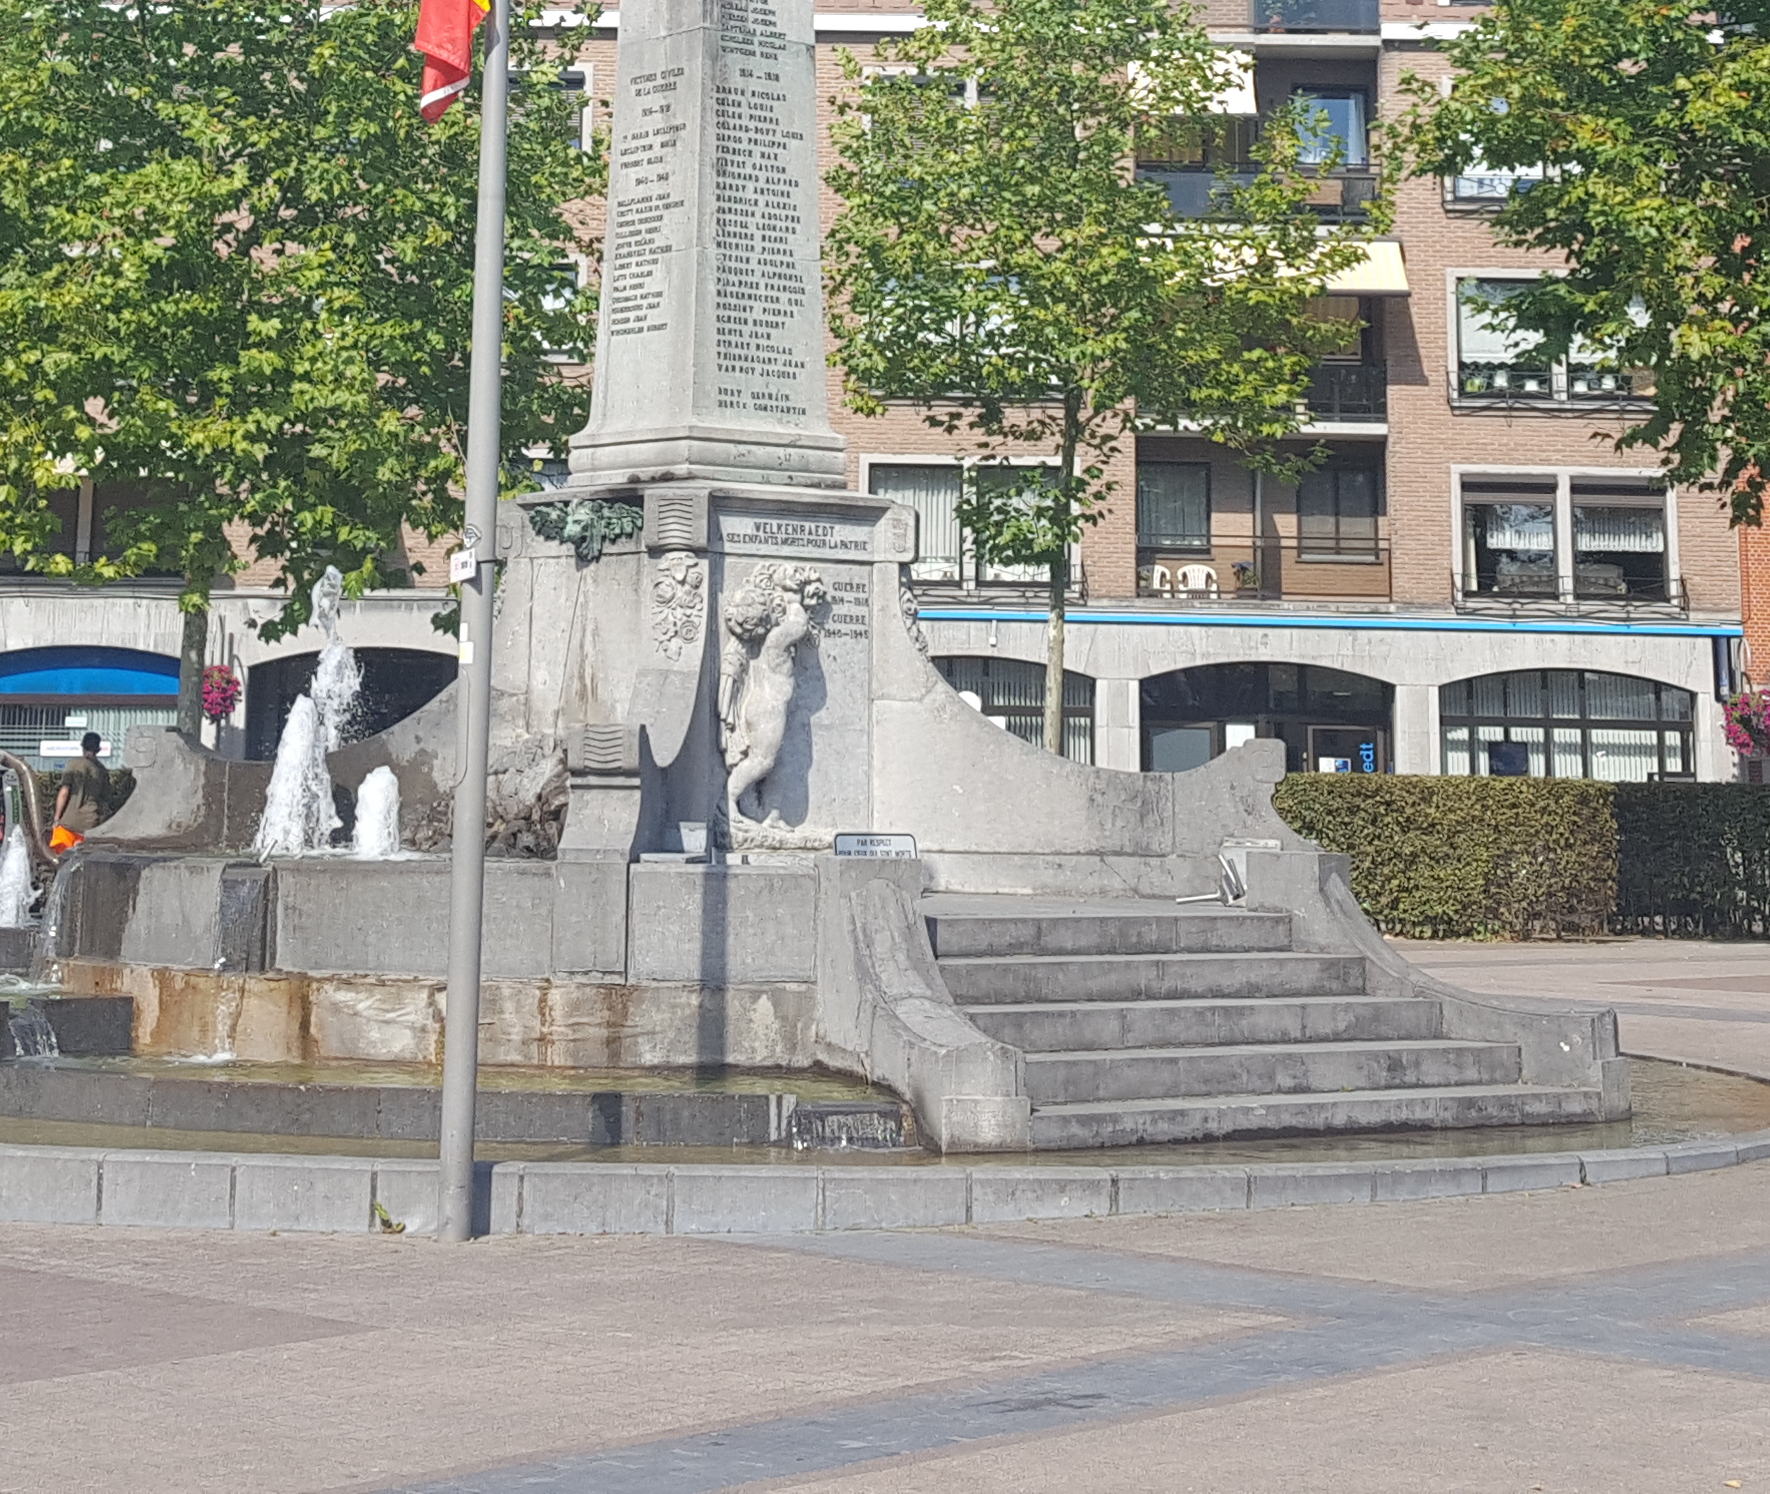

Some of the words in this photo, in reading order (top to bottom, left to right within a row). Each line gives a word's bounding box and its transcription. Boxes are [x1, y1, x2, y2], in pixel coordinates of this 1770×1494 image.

[751, 90, 787, 102] NICOLAS
[749, 114, 780, 126] PIERRE
[748, 137, 787, 150] PHILIPPE
[752, 162, 786, 174] GASTON
[765, 176, 799, 188] ALFRED
[753, 187, 791, 199] ANTOINE
[765, 200, 798, 212] ALEXIS
[761, 211, 801, 224] ADOLPHE
[761, 246, 794, 258] PIERRE
[757, 257, 796, 270] ADOLPHE
[761, 269, 804, 284] ALPHONSE
[762, 307, 795, 319] PIERRE
[748, 330, 772, 341] JEAN
[755, 343, 793, 356] NICOLAS
[782, 359, 805, 369] JEAN
[759, 367, 797, 380] JACQUES
[753, 402, 807, 416] CONSTANTIN
[753, 521, 835, 538] WELKENRAEDT
[726, 533, 741, 543] SES
[743, 533, 779, 546] ENFANTS
[780, 537, 806, 547] MORTS
[806, 538, 827, 549] POUR
[828, 540, 838, 549] LA
[839, 540, 868, 551] PATRIE
[832, 582, 867, 593] GUERRE
[831, 614, 867, 625] GUERRE
[856, 838, 868, 846] PAR
[869, 838, 892, 847] RESPECT
